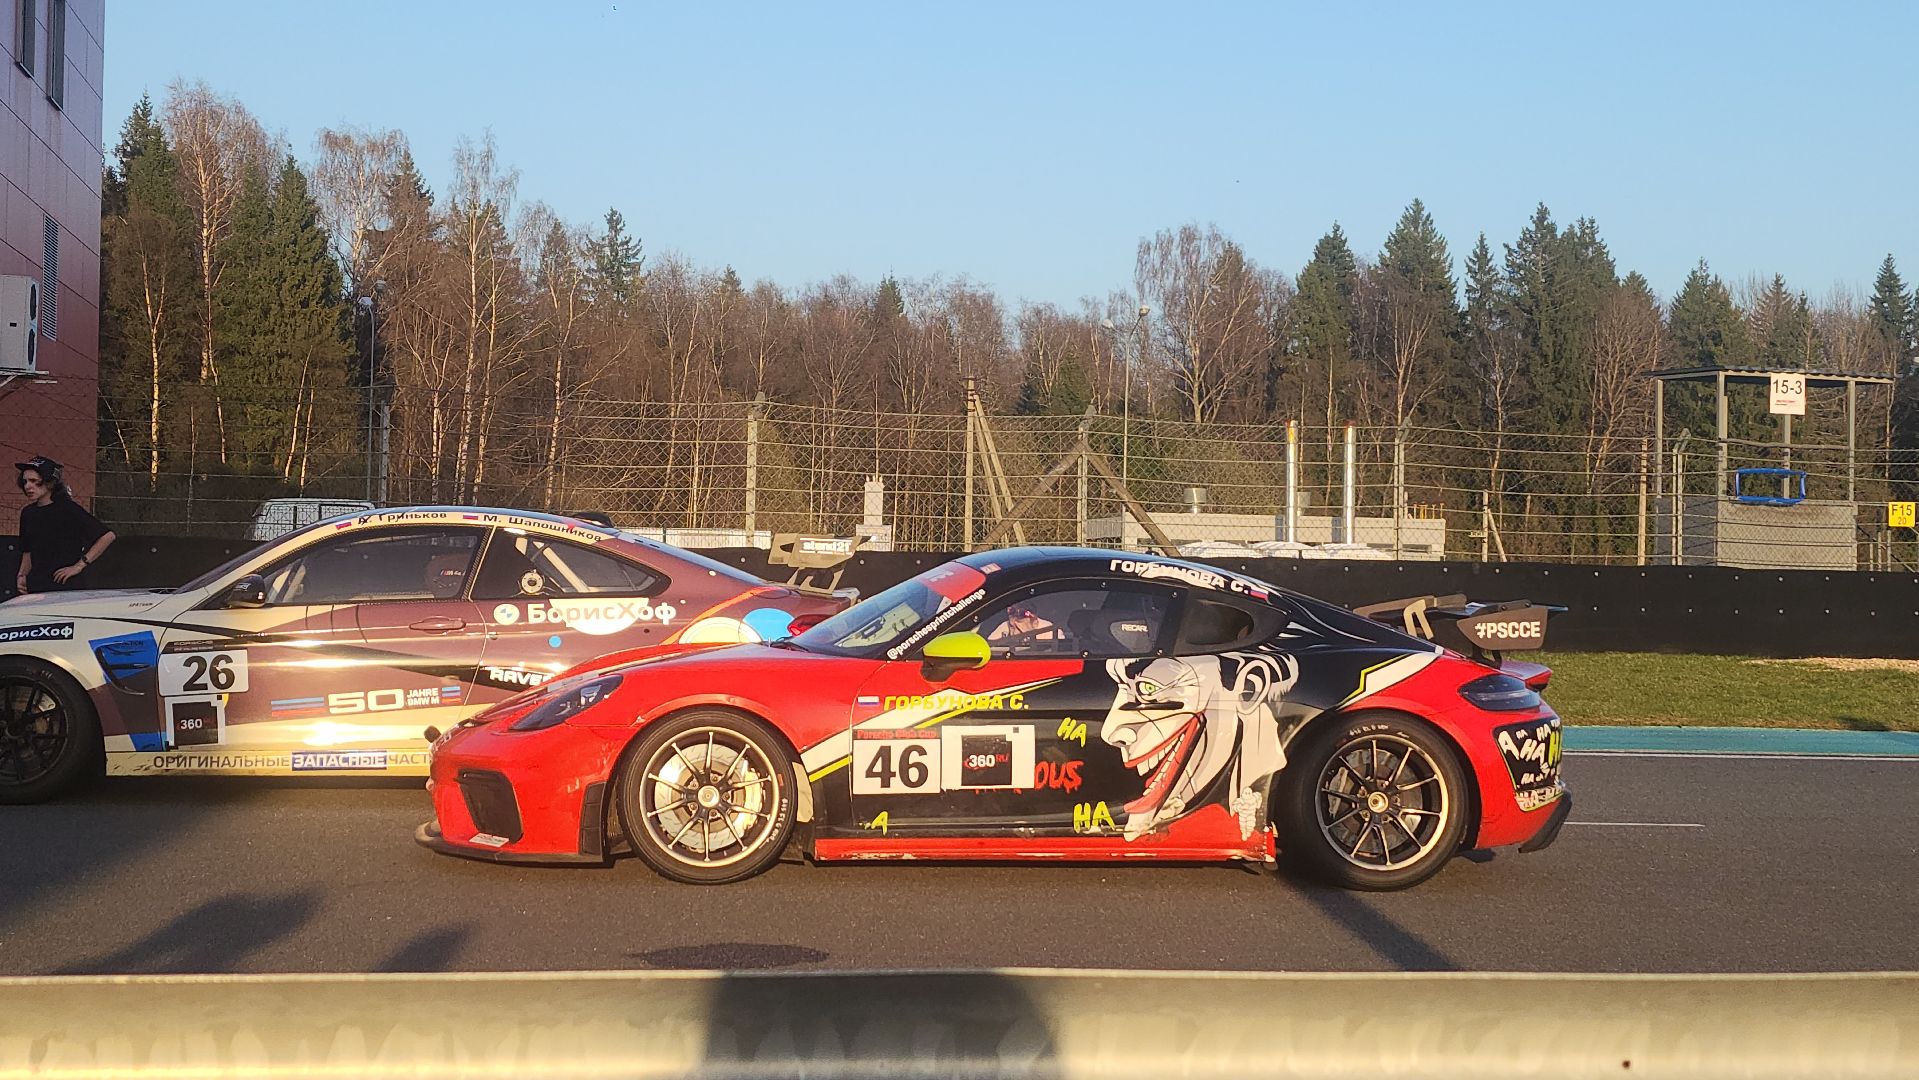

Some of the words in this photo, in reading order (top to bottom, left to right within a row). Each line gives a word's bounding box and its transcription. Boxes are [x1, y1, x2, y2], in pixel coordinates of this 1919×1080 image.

[1773, 379, 1803, 394] 15-3
[1891, 504, 1912, 516] F15
[508, 516, 602, 541] Шапошников
[527, 602, 677, 625] БорисХоф
[0, 625, 73, 640] орисХоф
[1475, 621, 1541, 638] #PSCCE
[183, 654, 236, 692] 26
[328, 688, 404, 714] 50
[407, 688, 439, 698] JAHRE
[883, 694, 1004, 711] ГОРБУНОВА
[180, 718, 203, 730] 360
[153, 755, 290, 770] ОРИГИНАЛЬНЫЕ
[293, 753, 386, 768] ЗАПАСНЫЕ
[389, 754, 429, 765] ЧАСТ
[865, 744, 929, 789] 46
[863, 811, 888, 836] A
[1073, 801, 1115, 834] HA
